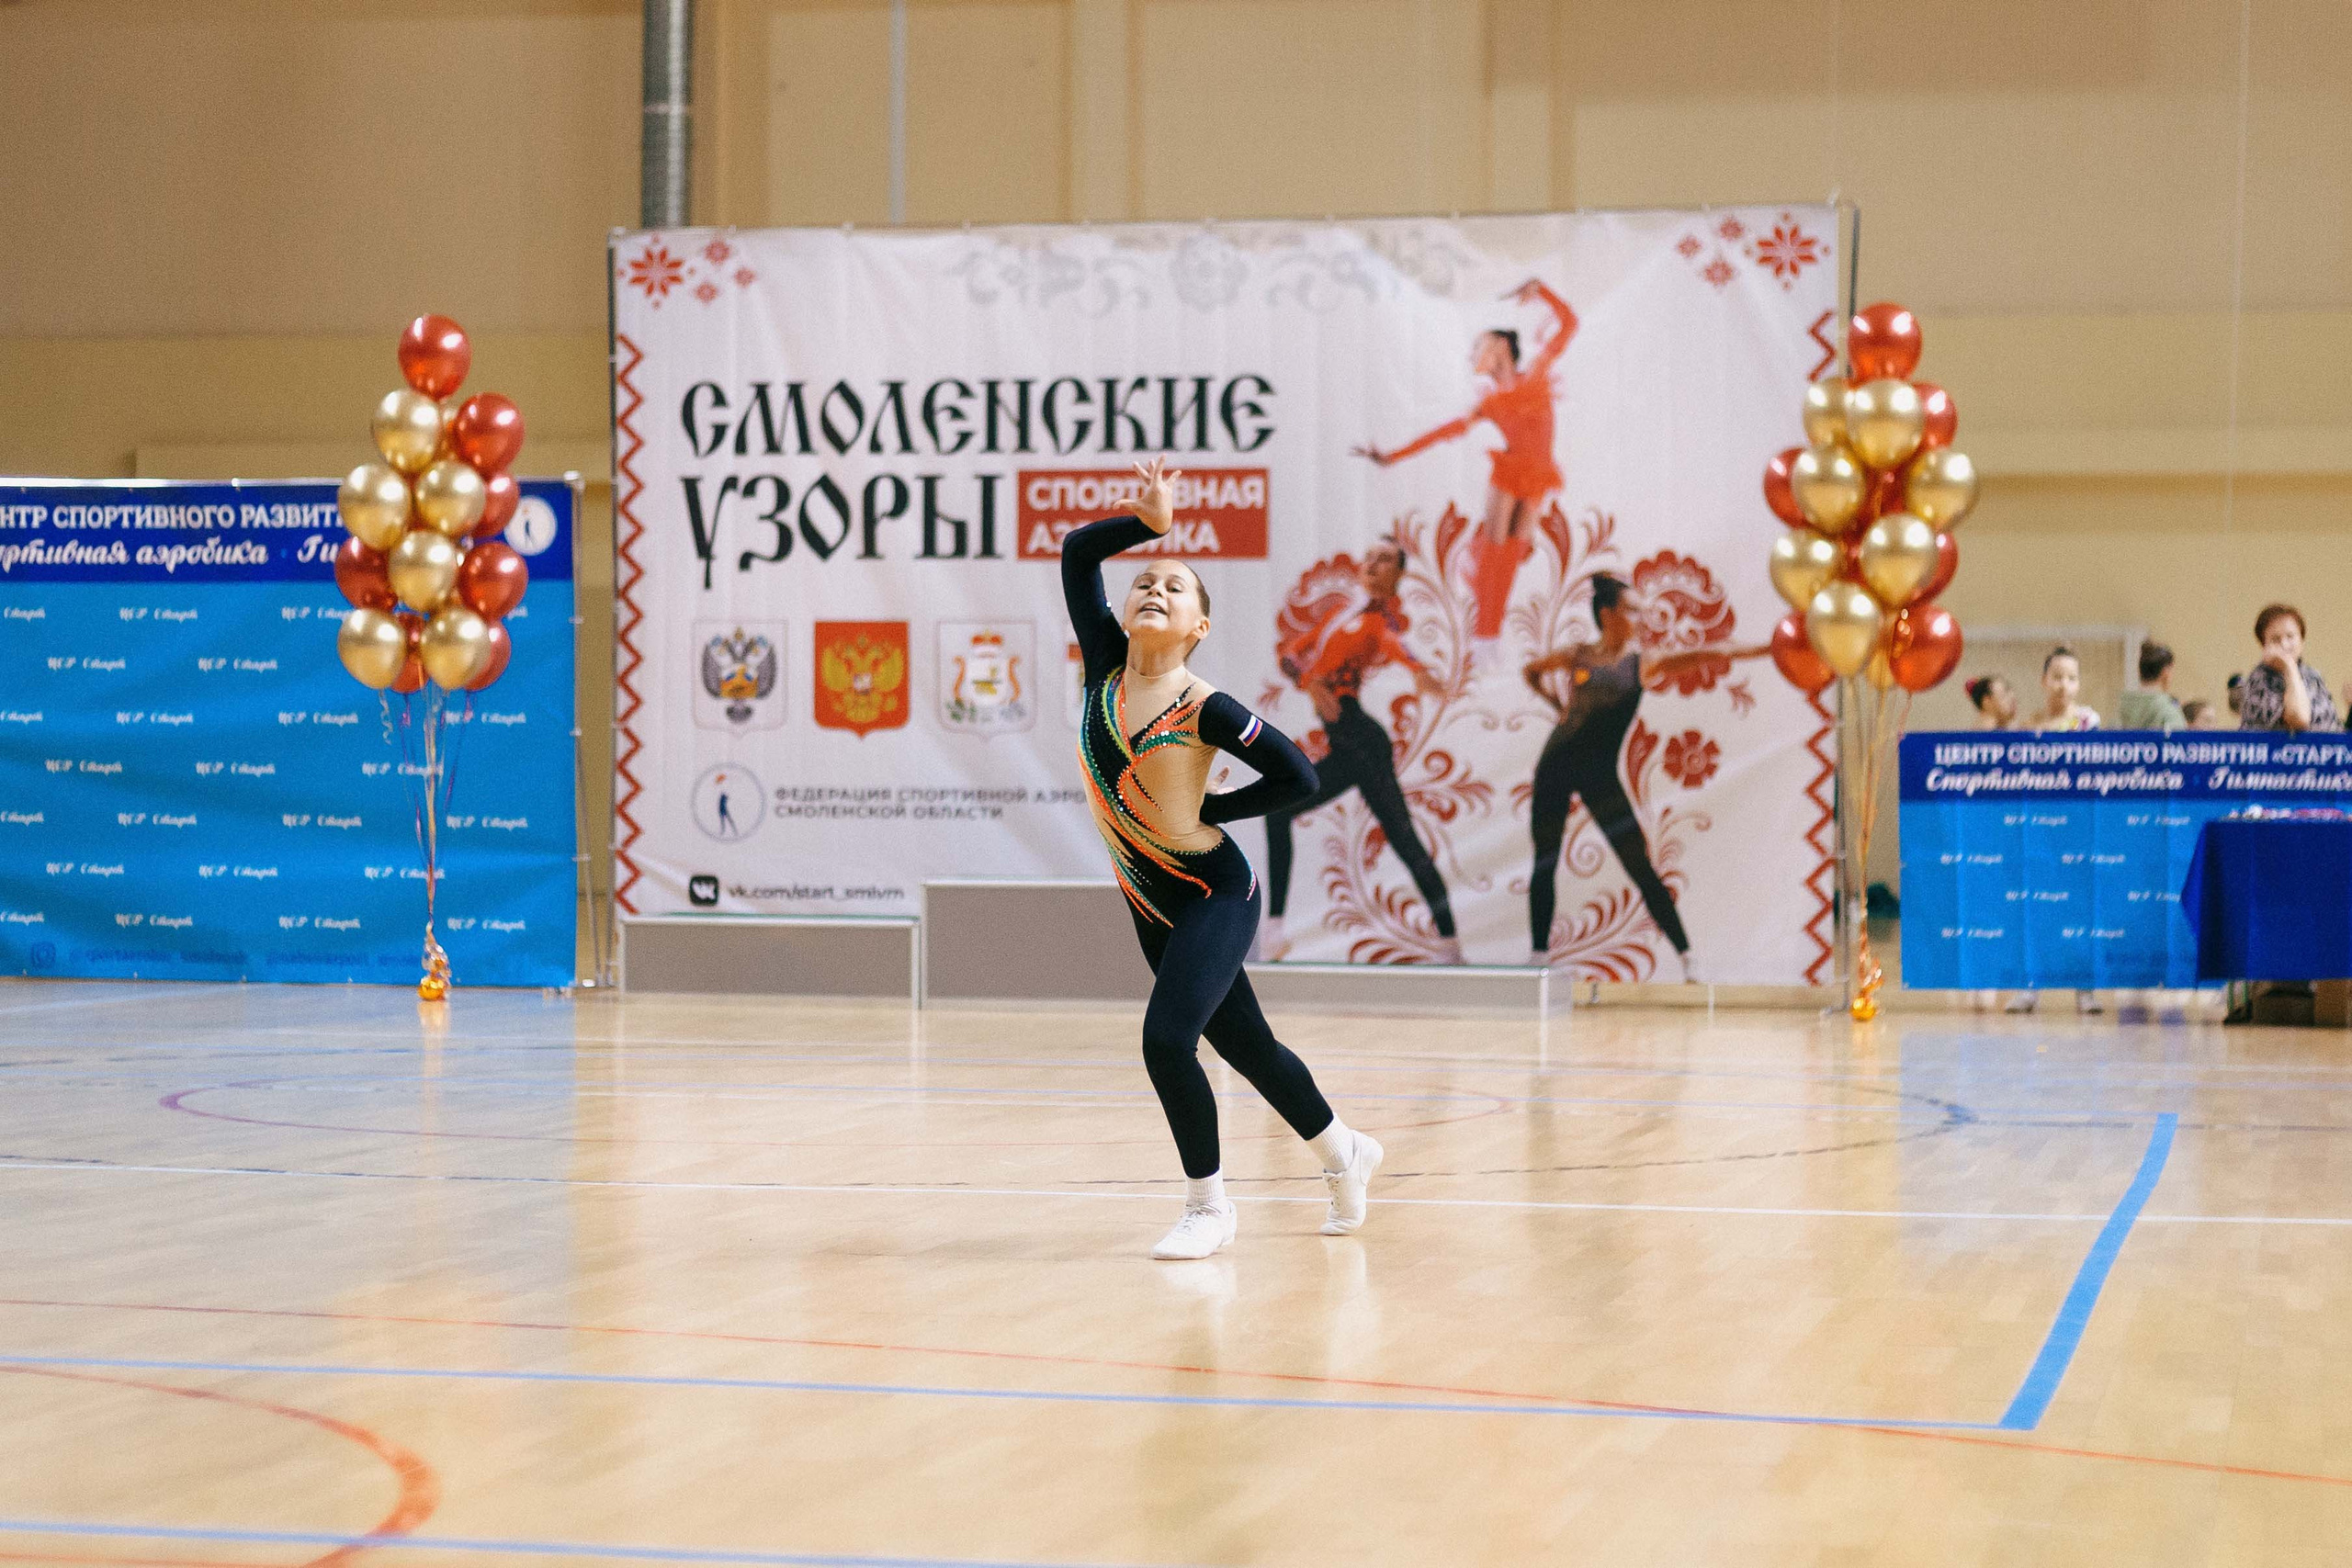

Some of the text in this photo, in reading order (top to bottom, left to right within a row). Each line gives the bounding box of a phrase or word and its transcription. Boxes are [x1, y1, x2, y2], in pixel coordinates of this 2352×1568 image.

[681, 374, 1277, 457] СМОЛЕНСКИЕ
[1026, 476, 1266, 511] СПОРТВНАЯ
[52, 504, 235, 529] СПОРТИВНОГО
[681, 472, 1003, 590] УЗОРЫ
[135, 535, 269, 574] аэробика
[1934, 742, 2005, 767] ЦЕНТР
[2007, 742, 2158, 764] СПОРТИВНОГО
[2162, 742, 2268, 765] РАЗВИТИЯ
[775, 787, 892, 803] ФЕДЕРАЦИЯ
[899, 786, 1026, 804] СПОРТИВНОЙ
[1926, 766, 2071, 796] Спортивная
[2076, 765, 2184, 796] аэробика
[775, 804, 1004, 820] СМОЛЕНСКОЙ ОБЛАСТИ
